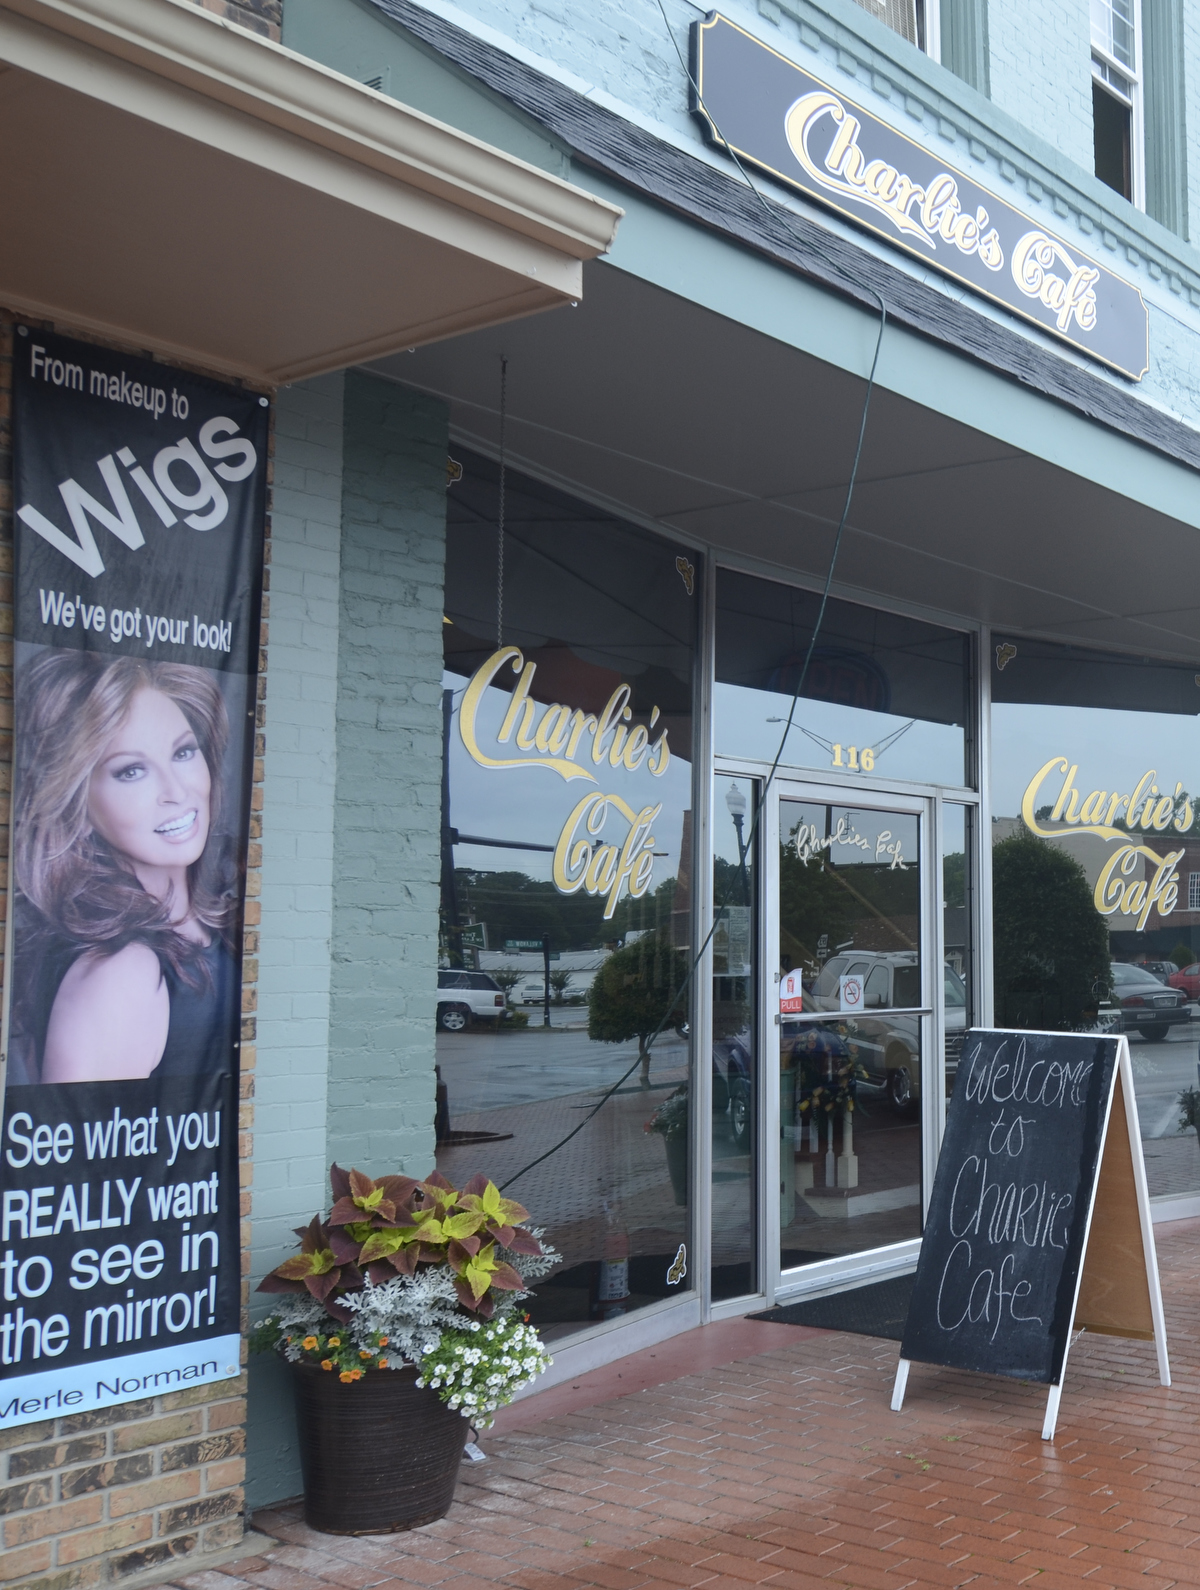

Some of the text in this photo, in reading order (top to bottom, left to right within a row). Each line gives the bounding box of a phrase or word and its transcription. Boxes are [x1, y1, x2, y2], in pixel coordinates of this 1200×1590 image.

[783, 91, 1099, 332] Charlie's Café
[30, 344, 190, 420] From makeup to
[16, 416, 257, 579] Wigs
[38, 588, 233, 653] We've got your look!
[459, 645, 671, 786] Charlie's
[831, 743, 876, 772] 116
[1021, 756, 1195, 843] Charlie's
[552, 791, 663, 920] Café
[1094, 844, 1186, 932] Café
[781, 1000, 801, 1010] PULL
[6, 1106, 220, 1168] See what you
[989, 1108, 1036, 1157] to
[2, 1171, 219, 1242] REALLY want
[0, 1221, 219, 1301] to see in
[937, 1240, 1043, 1345] Cafe
[0, 1275, 217, 1366] the mirror!
[96, 1359, 218, 1401] Norman
